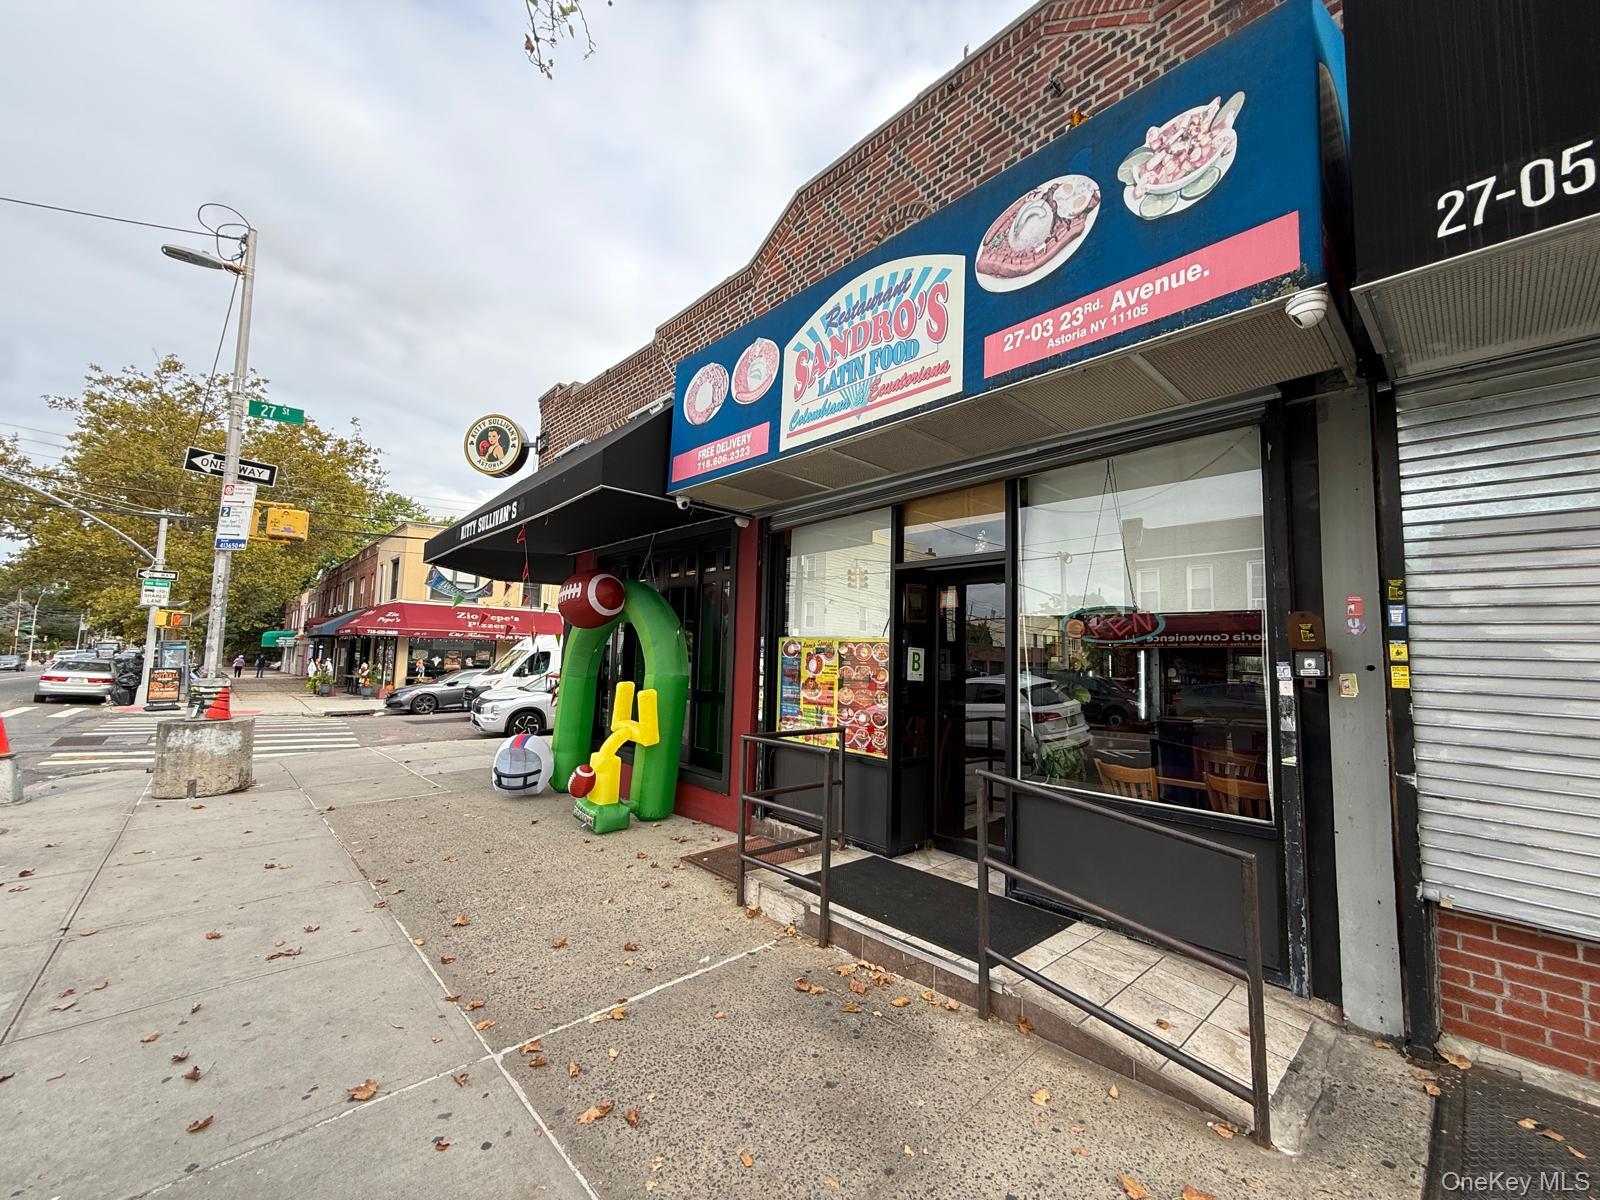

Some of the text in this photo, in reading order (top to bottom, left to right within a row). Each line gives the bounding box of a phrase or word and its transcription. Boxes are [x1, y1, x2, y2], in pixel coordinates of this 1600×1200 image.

[1437, 140, 1596, 238] 27-05
[825, 272, 913, 334] Restaurant
[1002, 318, 1054, 352] 27-03
[1110, 262, 1210, 312] Avenue.
[794, 280, 949, 402] SANDRO'S
[1046, 304, 1149, 350] Astoria NY 11105
[818, 338, 920, 398] LATIN FOOD
[789, 398, 851, 432] Colombiana
[868, 360, 950, 402] Ecuatoriana
[260, 404, 290, 418] 27 St
[471, 418, 518, 442] KITTY SULLIVAN'S
[696, 446, 750, 471] 718.606.2323
[698, 432, 752, 461] FREE DELIVERY
[200, 457, 265, 478] ONE WAY
[476, 460, 504, 468] ASTORIA
[222, 507, 230, 517] 2
[460, 501, 518, 540] KITTY SULLIVAN'S
[486, 614, 520, 622] epe's
[1066, 611, 1154, 638] OPEN
[912, 652, 920, 671] B
